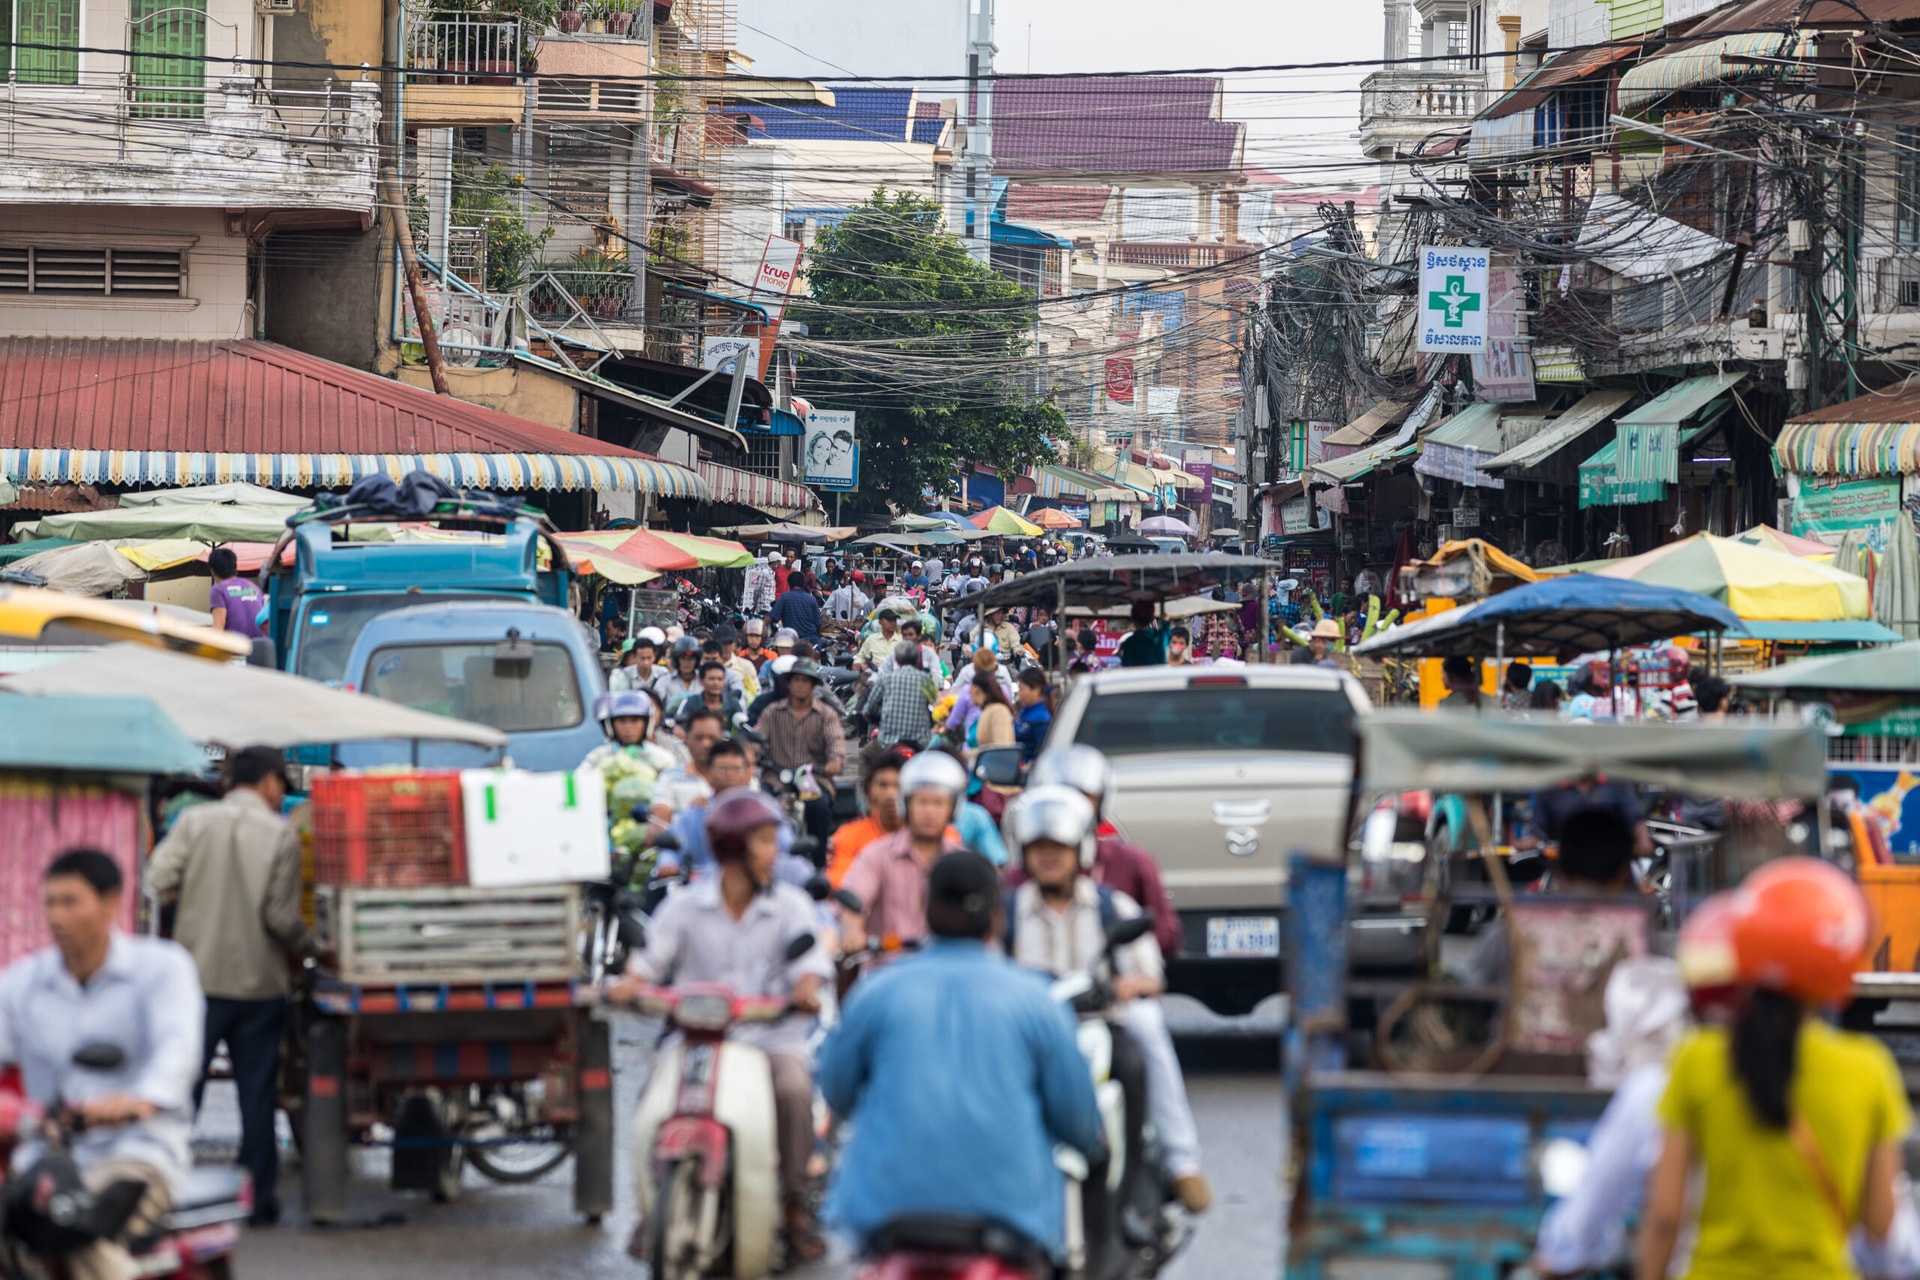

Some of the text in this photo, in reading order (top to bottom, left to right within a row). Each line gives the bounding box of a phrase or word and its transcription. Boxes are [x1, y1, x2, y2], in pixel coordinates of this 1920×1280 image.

[763, 263, 790, 280] true
[760, 275, 788, 290] money
[1313, 424, 1331, 432] true
